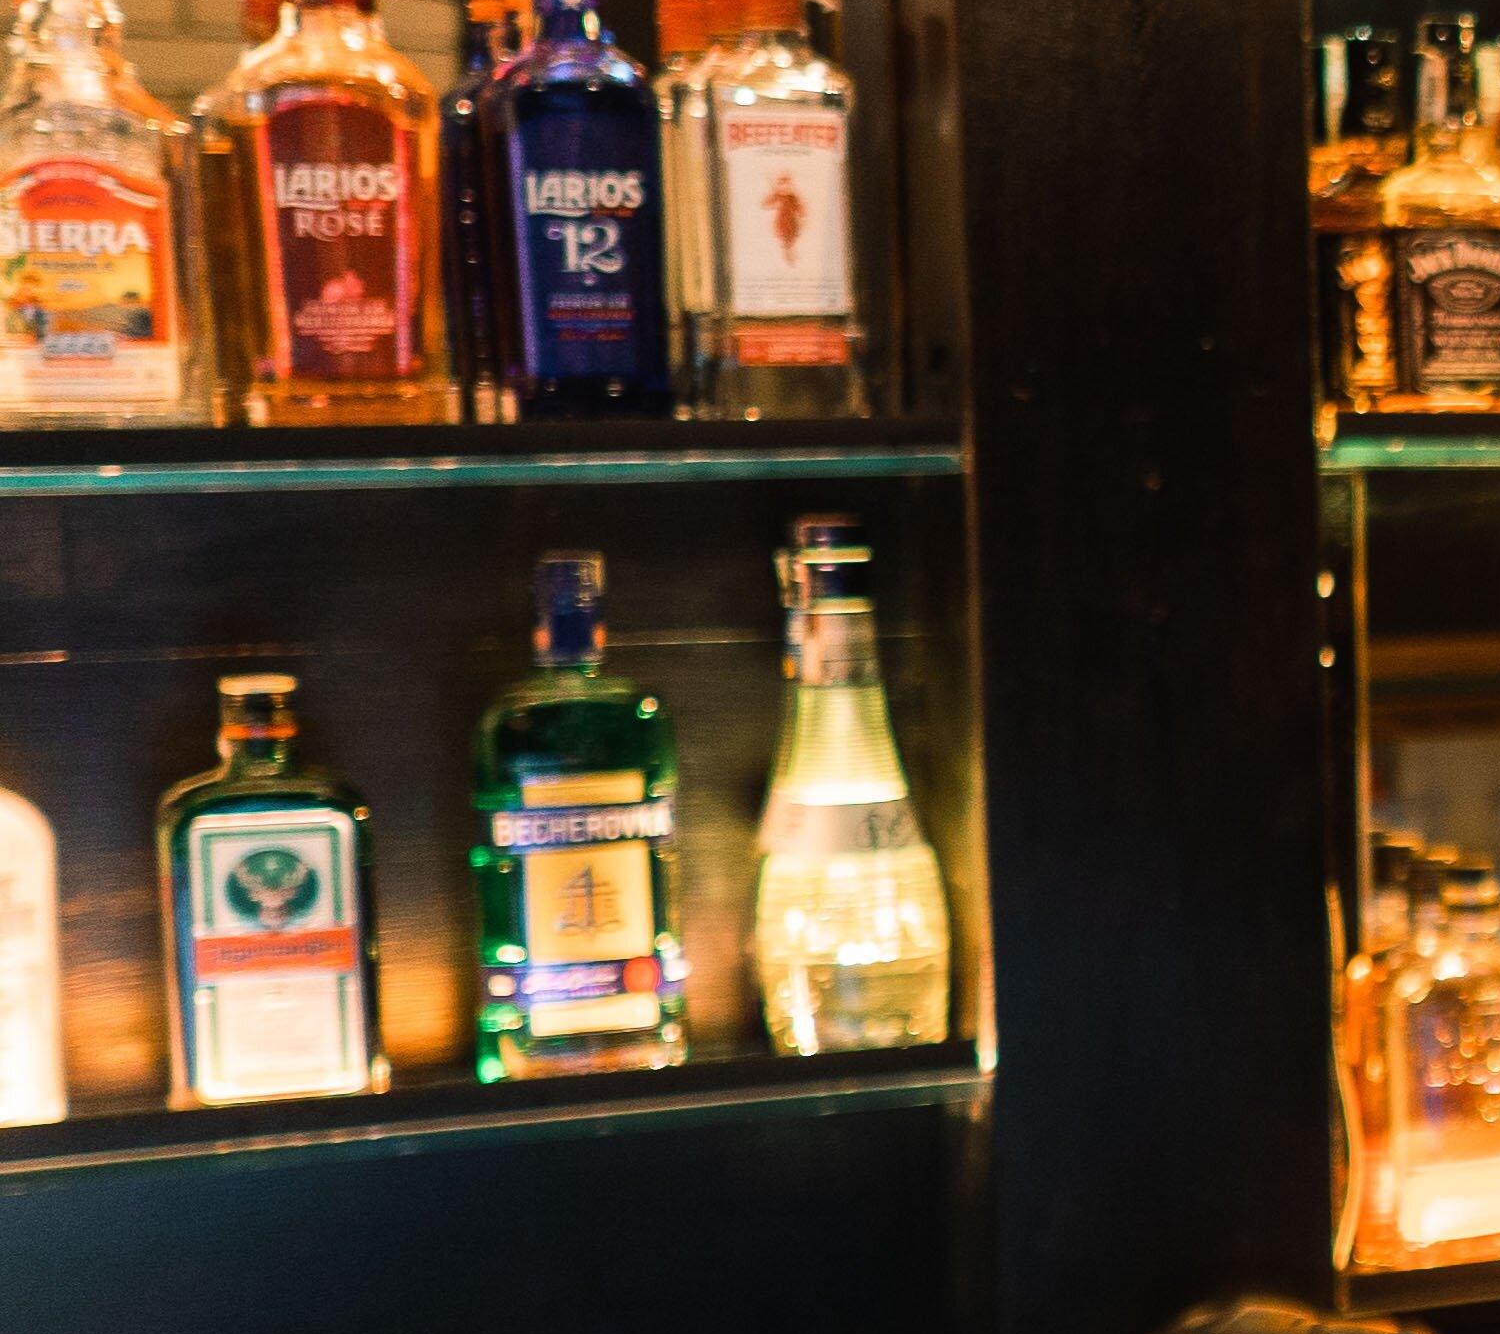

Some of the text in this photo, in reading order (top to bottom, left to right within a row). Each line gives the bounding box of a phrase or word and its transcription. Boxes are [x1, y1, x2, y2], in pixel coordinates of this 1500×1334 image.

[272, 161, 400, 210] LARIOS
[524, 169, 646, 217] LARIOS
[546, 216, 625, 276] 12
